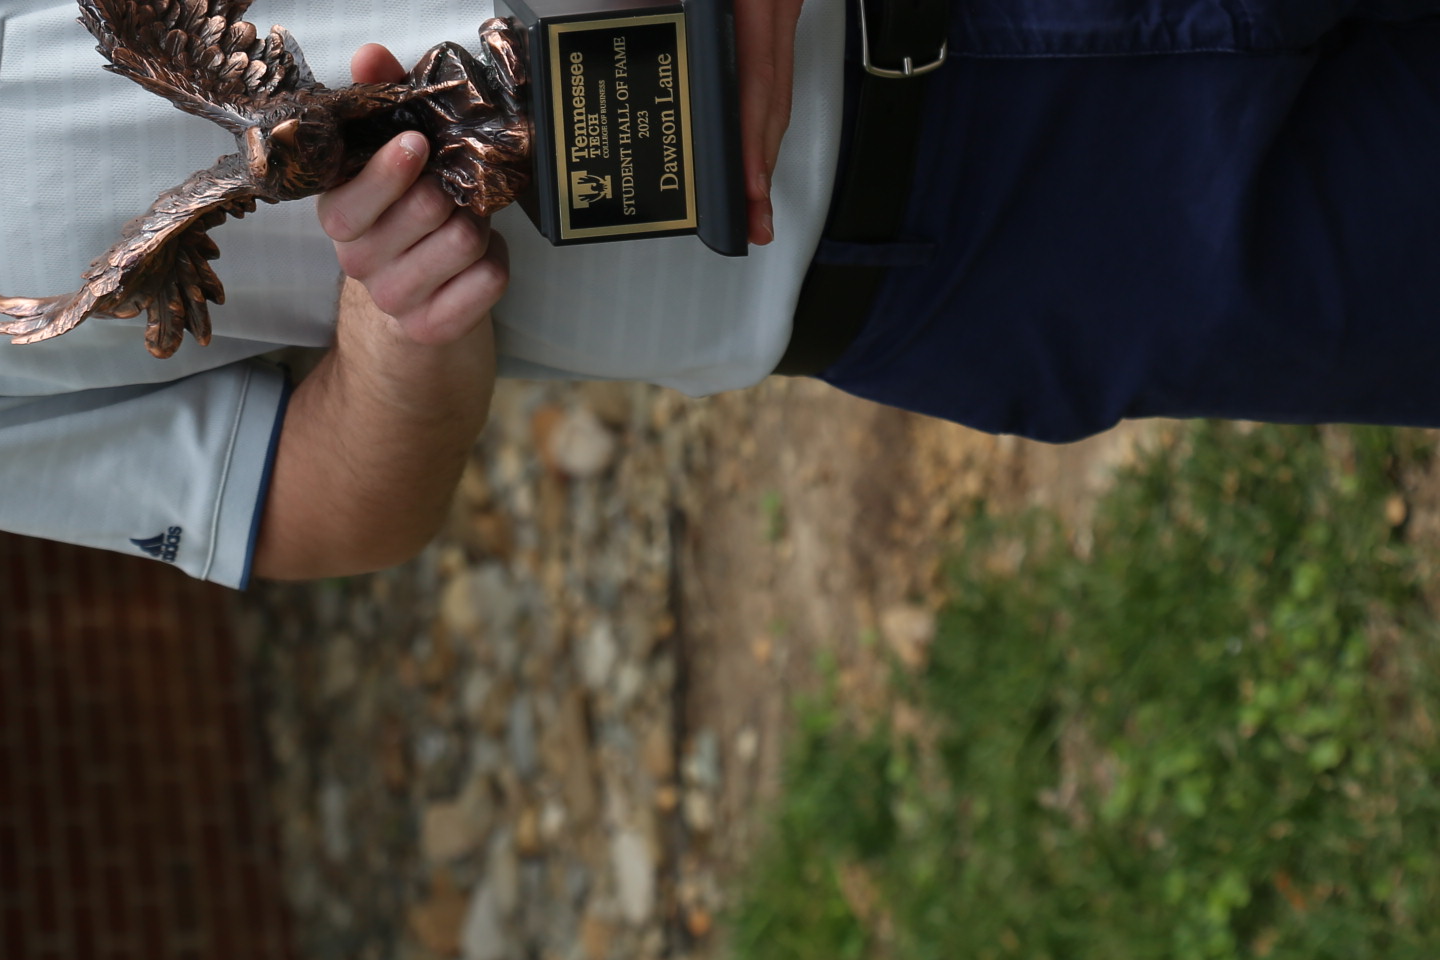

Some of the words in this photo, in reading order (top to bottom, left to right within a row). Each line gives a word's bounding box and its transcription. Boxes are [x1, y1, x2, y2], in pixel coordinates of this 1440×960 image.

[614, 36, 627, 77] FAME
[599, 80, 607, 113] BUSINESS
[616, 81, 629, 100] OF
[655, 53, 674, 103] Lane
[569, 52, 589, 162] Tennessee
[601, 114, 608, 124] OF
[617, 103, 632, 144] HALL
[638, 110, 650, 138] 2023
[588, 113, 601, 158] TECH
[602, 125, 610, 158] COLLEGE
[659, 110, 679, 191] Dawson
[620, 148, 636, 215] STUDENT
